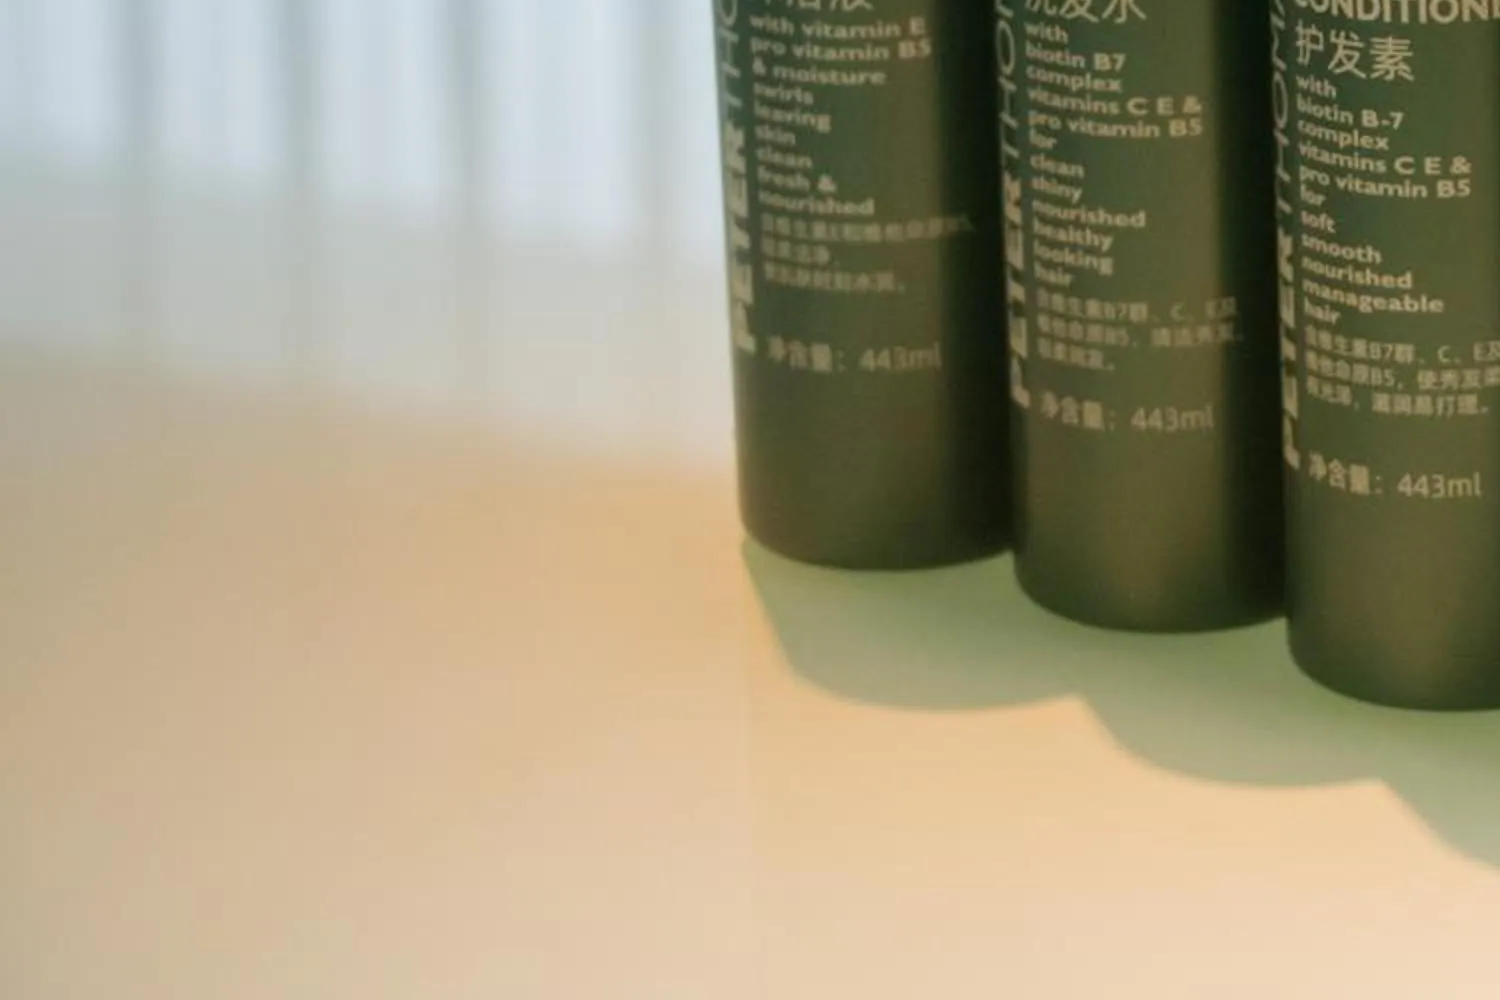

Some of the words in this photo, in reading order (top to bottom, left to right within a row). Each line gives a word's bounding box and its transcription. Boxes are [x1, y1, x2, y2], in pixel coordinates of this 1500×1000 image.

[750, 14, 794, 35] with
[802, 23, 898, 39] vitamin
[910, 17, 925, 35] E
[1026, 22, 1068, 43] with
[750, 36, 786, 57] pro
[794, 40, 889, 61] vitamin
[899, 38, 931, 58] B5
[1026, 42, 1085, 68] biotin
[1094, 54, 1126, 72] B7
[1296, 19, 1414, 81] 护发素
[753, 58, 767, 76] &
[773, 65, 887, 85] moisture
[1027, 66, 1122, 93] complex
[1297, 75, 1336, 98] with
[1028, 88, 1119, 115] vitamins
[1127, 97, 1148, 116] C
[1157, 98, 1174, 114] E
[1182, 97, 1202, 113] &
[1297, 94, 1353, 126] biotin
[1362, 110, 1404, 130] B-7
[755, 102, 832, 134] leaving
[1028, 111, 1060, 130] pro
[1068, 117, 1159, 137] vitamin
[1169, 118, 1202, 137] B5
[755, 124, 795, 146] skin
[1030, 130, 1057, 149] for
[1298, 120, 1389, 150] complex
[757, 145, 812, 168] clean
[1030, 155, 1084, 177] clean
[1299, 143, 1386, 173] vitamins
[1394, 156, 1415, 175] C
[1425, 157, 1441, 175] E
[1450, 156, 1471, 174] &
[759, 164, 810, 191] fresh
[818, 175, 836, 192] &
[1032, 176, 1082, 202] shiny
[1300, 165, 1331, 187] pro
[1336, 175, 1427, 199] vitamin
[1436, 179, 1471, 198] B5
[759, 191, 875, 216] nourished
[1302, 185, 1326, 206] for
[1033, 200, 1146, 228] nourished
[1302, 210, 1336, 233] soft
[1033, 219, 1113, 251] healthy
[1034, 242, 1113, 275] looking
[1303, 234, 1381, 264] smooth
[1035, 263, 1072, 286] hair
[1303, 257, 1413, 289] nourished
[1304, 280, 1444, 313] manageable
[1305, 297, 1341, 325] hair
[1131, 404, 1215, 431] 443ml
[1398, 473, 1482, 498] 443ml
